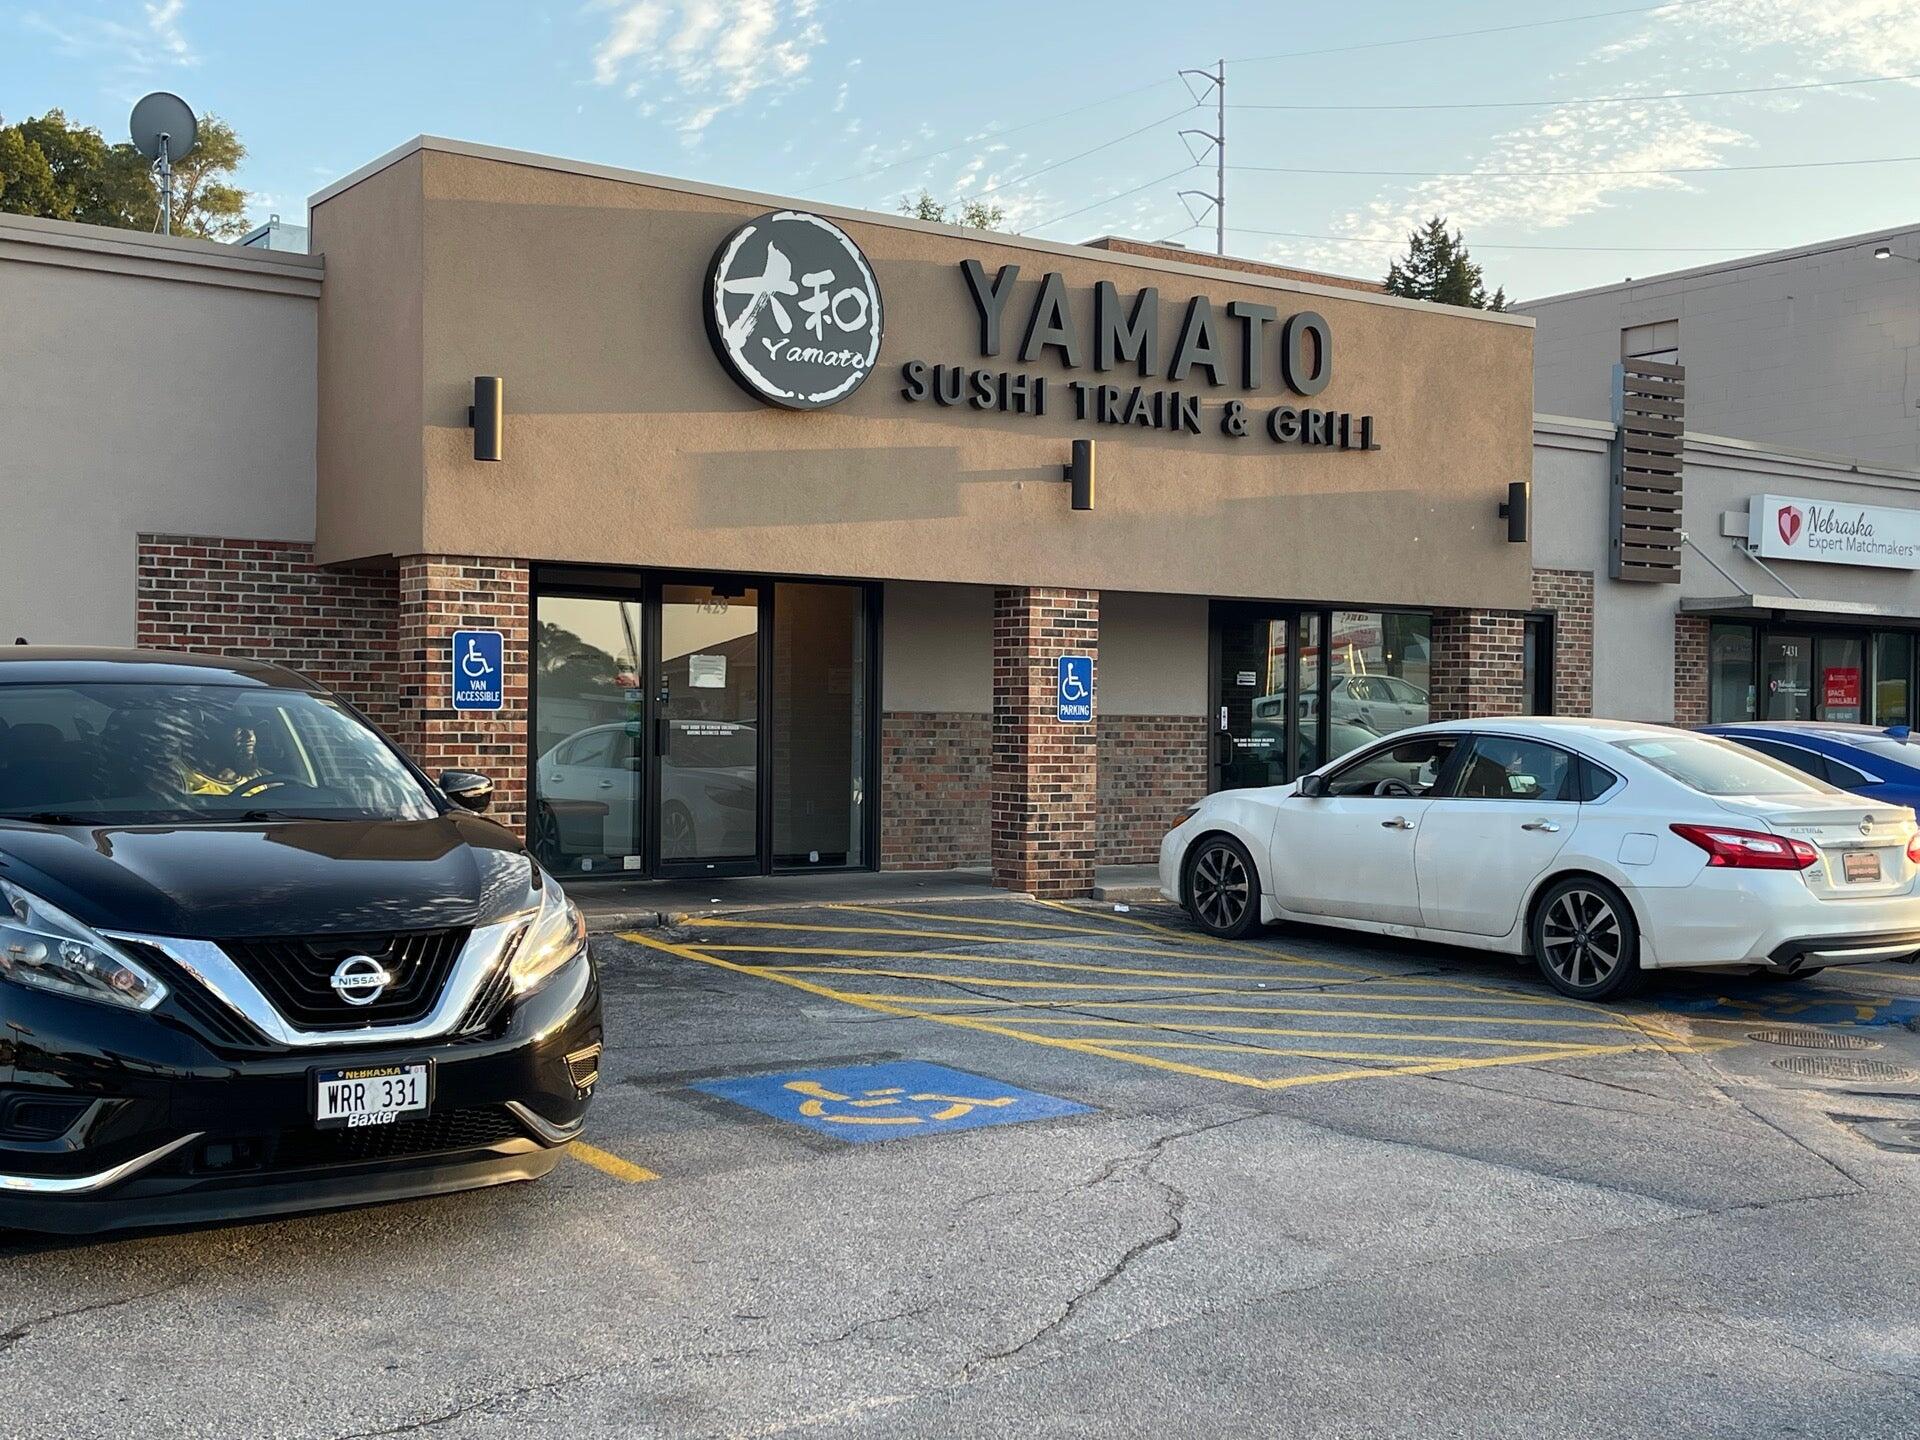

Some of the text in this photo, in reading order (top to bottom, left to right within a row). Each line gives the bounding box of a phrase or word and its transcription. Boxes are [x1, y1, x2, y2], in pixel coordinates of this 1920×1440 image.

[723, 241, 869, 350] 大和
[960, 259, 1332, 396] YAMATO
[761, 337, 866, 369] Yamato
[901, 360, 1381, 451] SUSHI TRAIN & GRILL
[1808, 506, 1875, 537] Nebraska
[1808, 533, 1843, 554] Expert
[695, 599, 728, 615] 7429
[1782, 645, 1798, 657] 7431
[470, 680, 487, 690] VAN
[1827, 689, 1846, 697] SPACE
[456, 691, 500, 702] ACCESSIBLE
[1827, 697, 1857, 705] AVAILABLE
[1060, 704, 1090, 716] PARKING
[345, 1067, 401, 1079] NEBRASKA
[328, 1078, 418, 1114] WRR 331
[347, 1110, 400, 1128] Baxter
